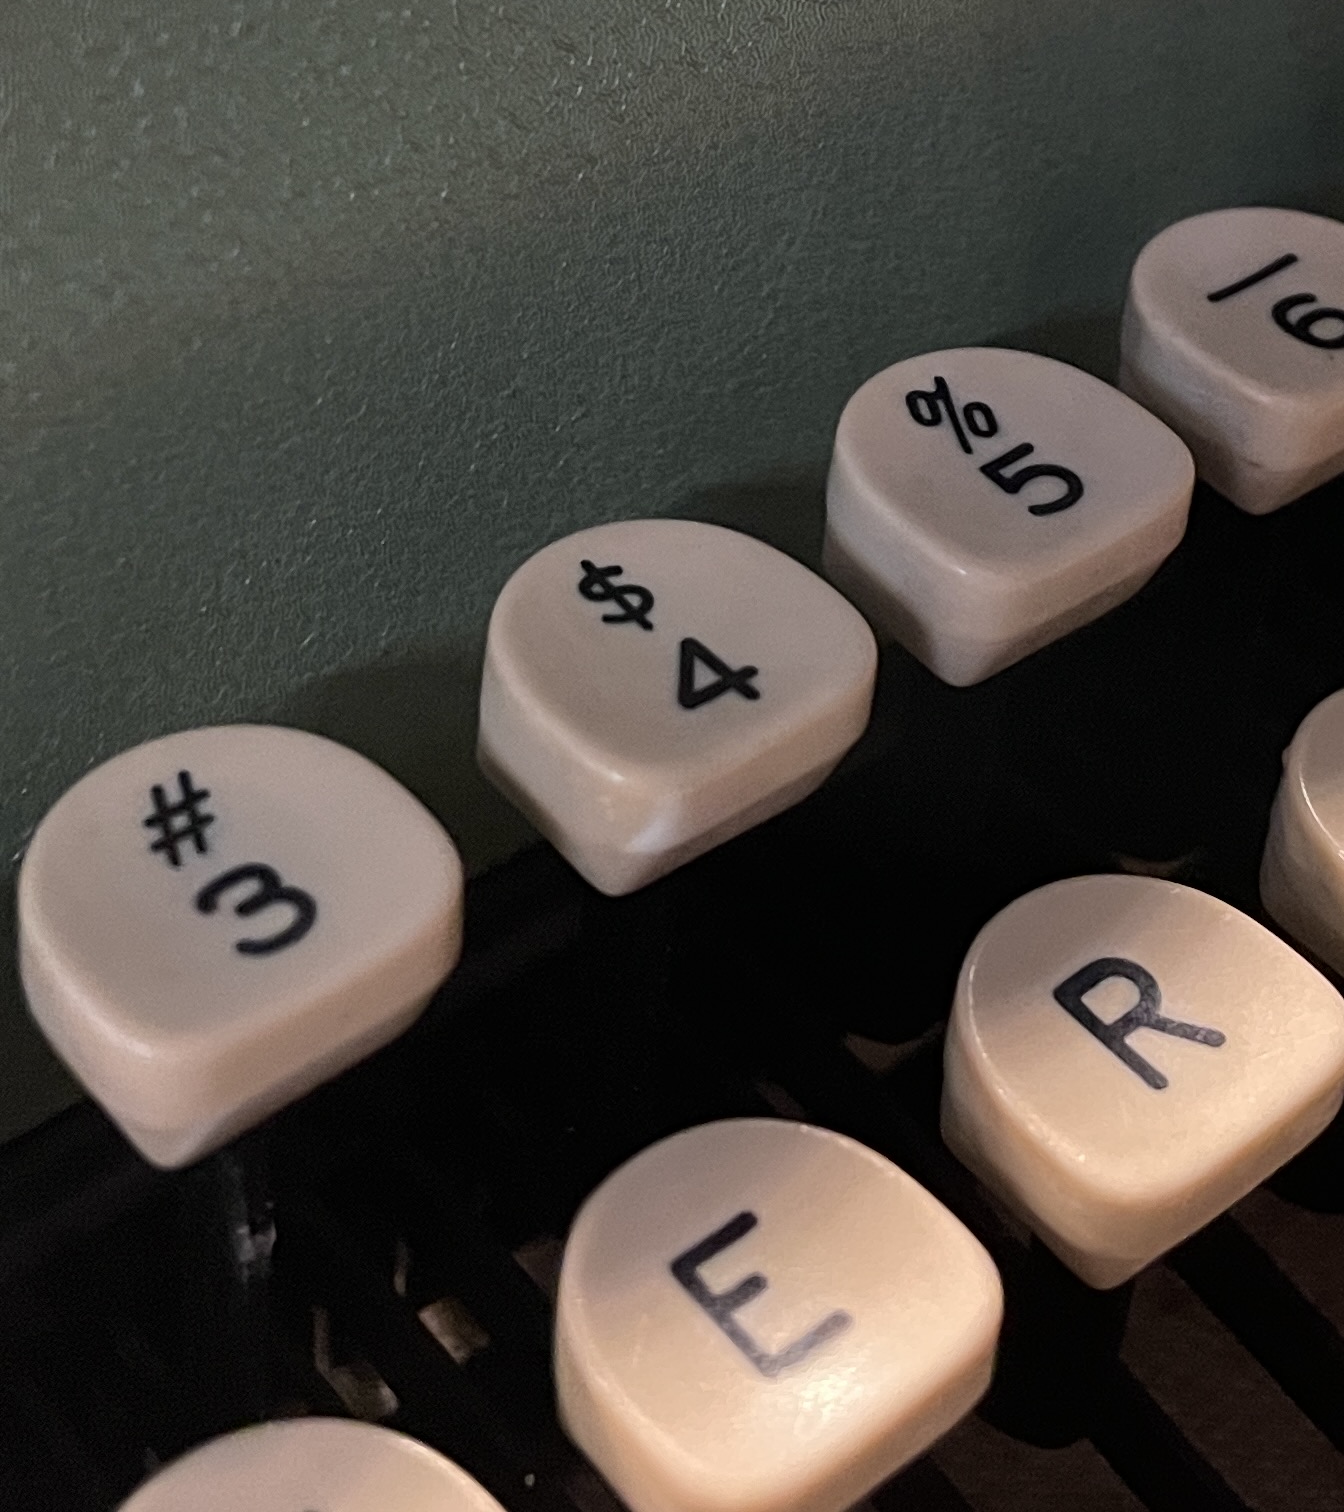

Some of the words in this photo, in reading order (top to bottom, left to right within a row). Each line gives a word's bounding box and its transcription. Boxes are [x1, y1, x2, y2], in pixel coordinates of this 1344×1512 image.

[904, 375, 999, 455] %
[978, 442, 1085, 517] 5
[577, 559, 655, 631] $
[677, 637, 761, 710] 4
[143, 770, 215, 867] #
[194, 863, 317, 957] 3
[1052, 956, 1227, 1090] R
[670, 1210, 854, 1379] E
